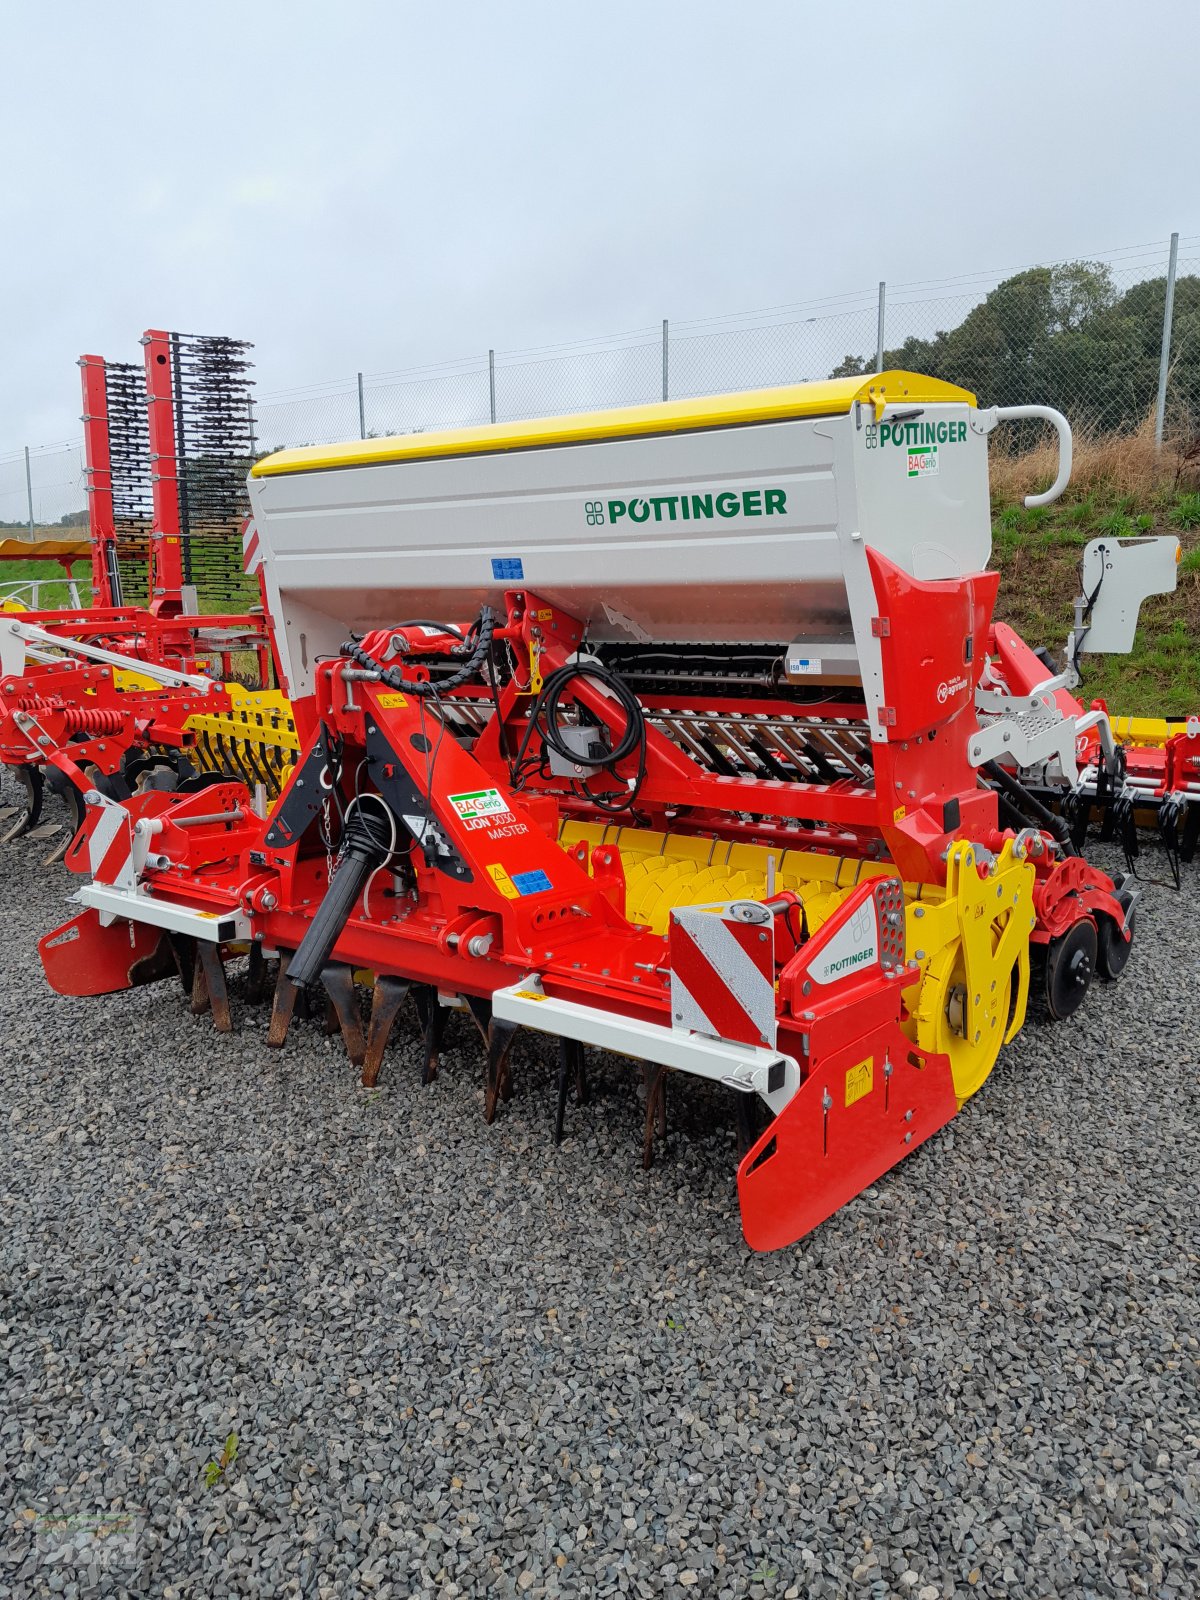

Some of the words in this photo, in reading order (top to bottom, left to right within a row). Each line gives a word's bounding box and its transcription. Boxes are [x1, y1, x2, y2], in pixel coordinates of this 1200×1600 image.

[880, 421, 967, 447] PÖTTINGER
[608, 489, 788, 524] PÖTTINGER
[455, 798, 502, 814] BAGeno
[462, 817, 491, 832] LION
[490, 812, 517, 826] 3030
[487, 823, 530, 841] MASTER
